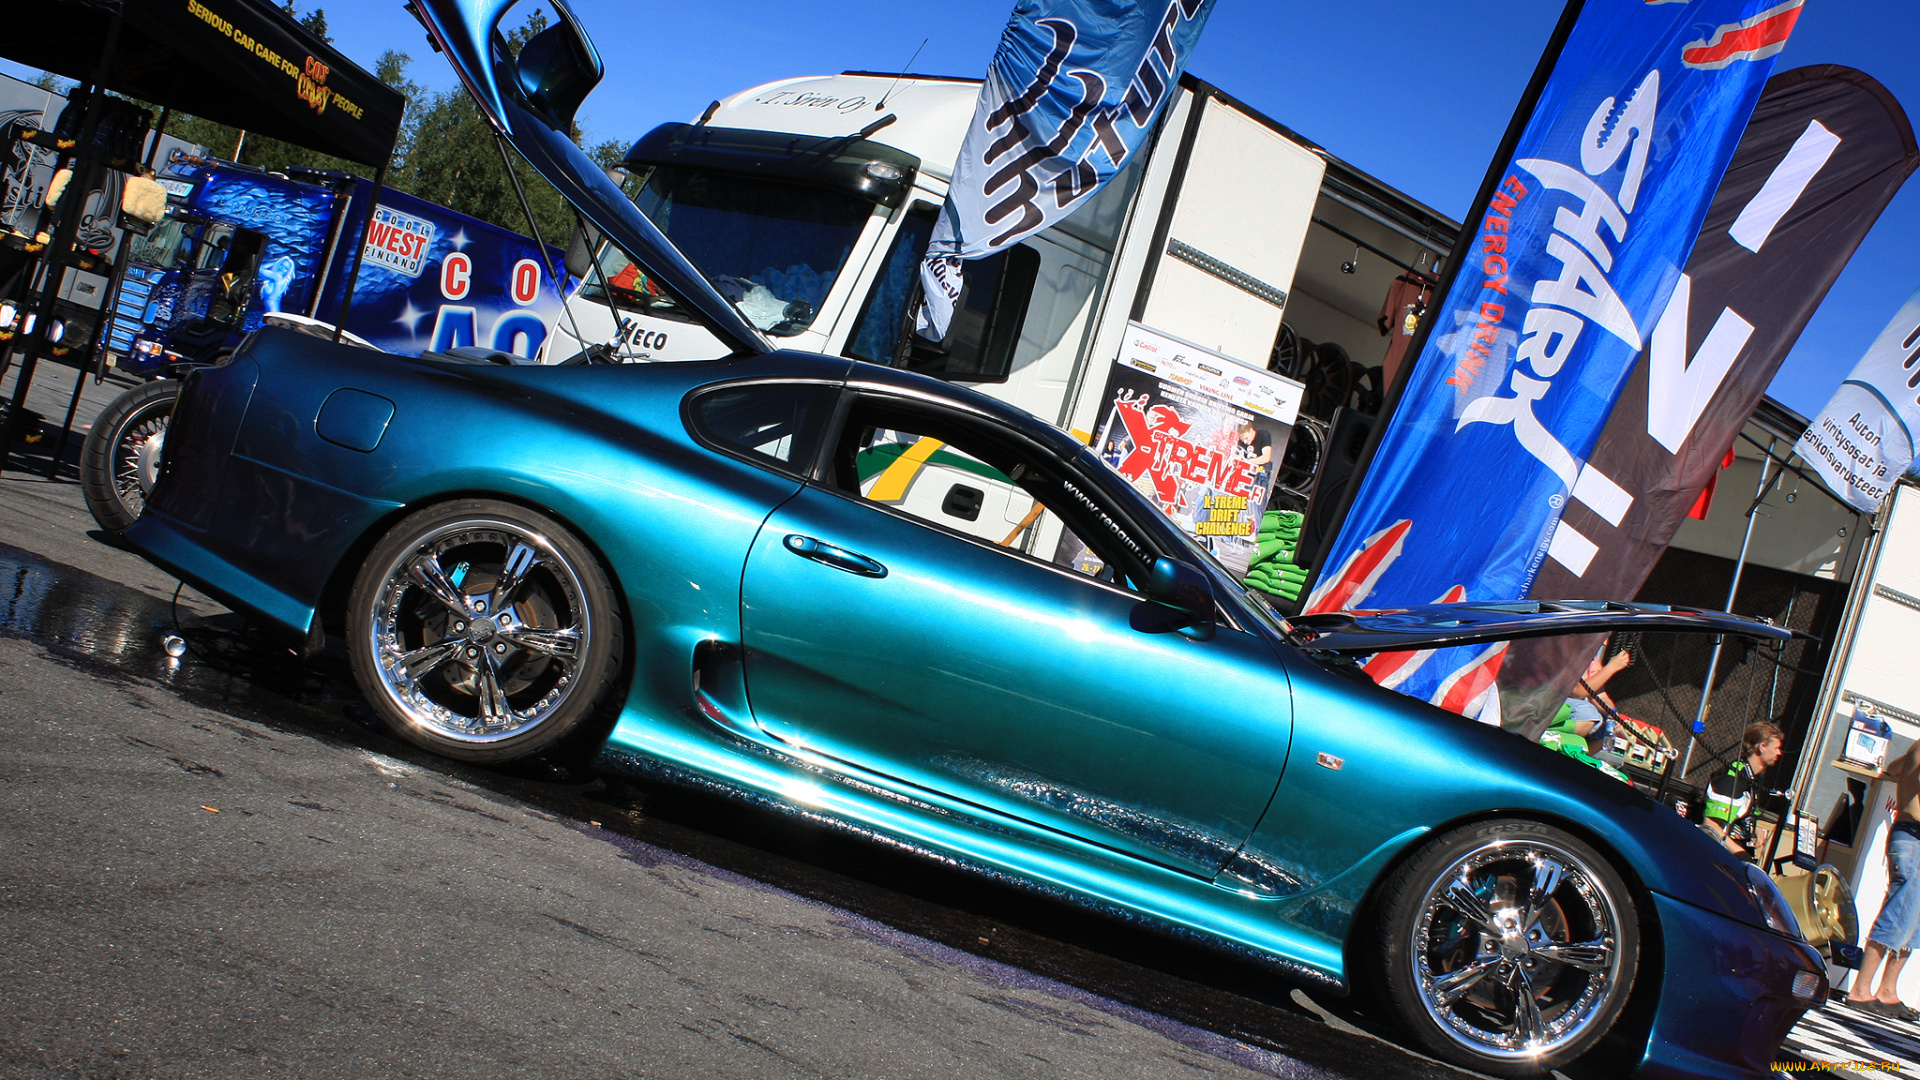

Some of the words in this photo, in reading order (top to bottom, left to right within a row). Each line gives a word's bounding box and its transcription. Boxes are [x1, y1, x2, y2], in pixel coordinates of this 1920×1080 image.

[187, 0, 233, 38] SERIOUS
[233, 28, 256, 53] CAR
[255, 43, 281, 70] CARE
[280, 58, 300, 80] FOR
[333, 92, 364, 120] PEOPLE
[374, 210, 427, 236] COOL
[1482, 174, 1529, 296] ENERGY
[367, 220, 428, 260] WEST
[363, 245, 417, 271] FINLAND
[1454, 69, 1661, 497] SHARK
[1139, 341, 1159, 354] Castrol
[1445, 301, 1506, 396] DRINK
[1848, 411, 1882, 448] Auton
[1821, 415, 1875, 472] viritysosat
[1871, 462, 1887, 478] ja
[1803, 428, 1883, 500] erikoisvarusteet
[1203, 495, 1248, 510] X-TREME
[1209, 508, 1240, 522] DRIFT
[1195, 521, 1252, 536] CHALLENGE
[1476, 823, 1548, 838] ECSTA
